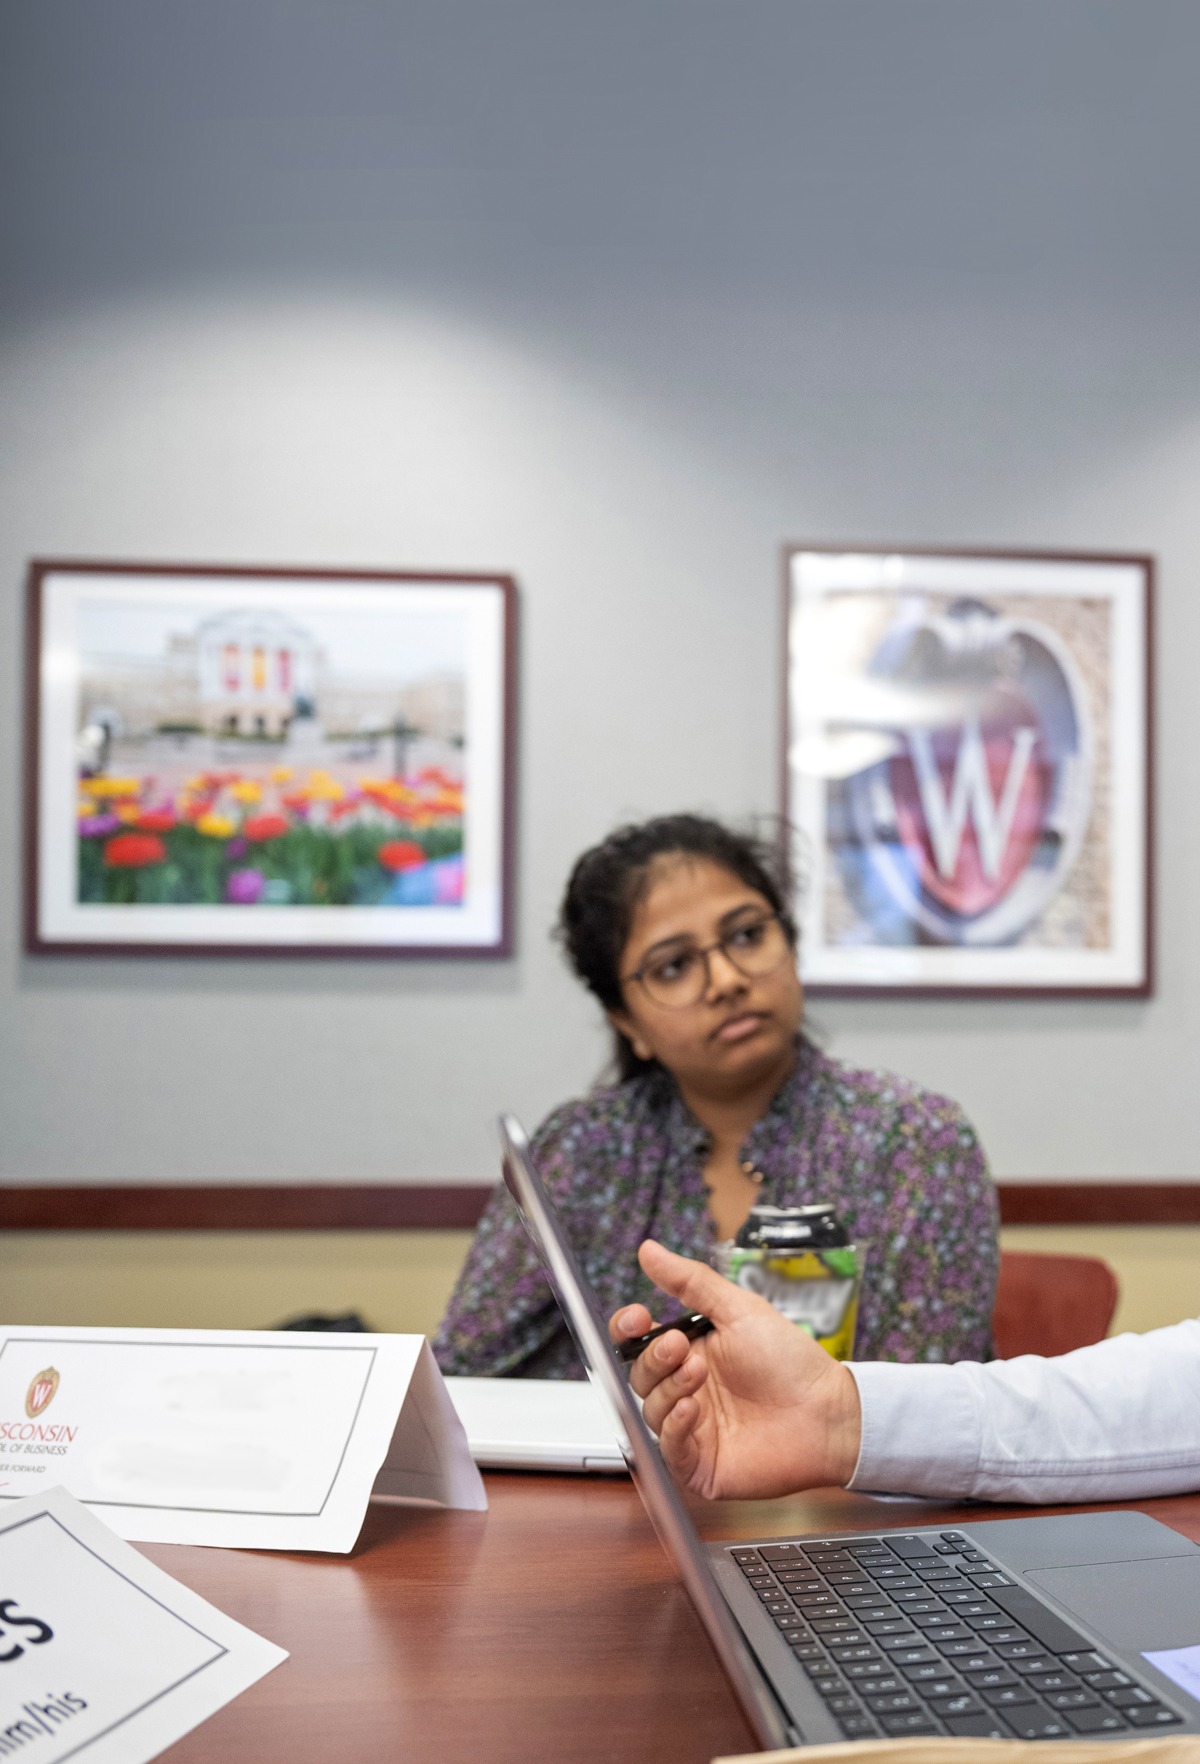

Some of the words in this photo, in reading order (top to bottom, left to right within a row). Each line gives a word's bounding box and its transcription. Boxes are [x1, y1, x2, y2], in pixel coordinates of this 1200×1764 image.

[906, 708, 1038, 882] W
[32, 1383, 52, 1409] W
[0, 1422, 78, 1442] SCONSIN
[9, 1443, 23, 1453] OF
[23, 1444, 68, 1455] BUSINESS
[10, 1464, 46, 1473] FORWARD
